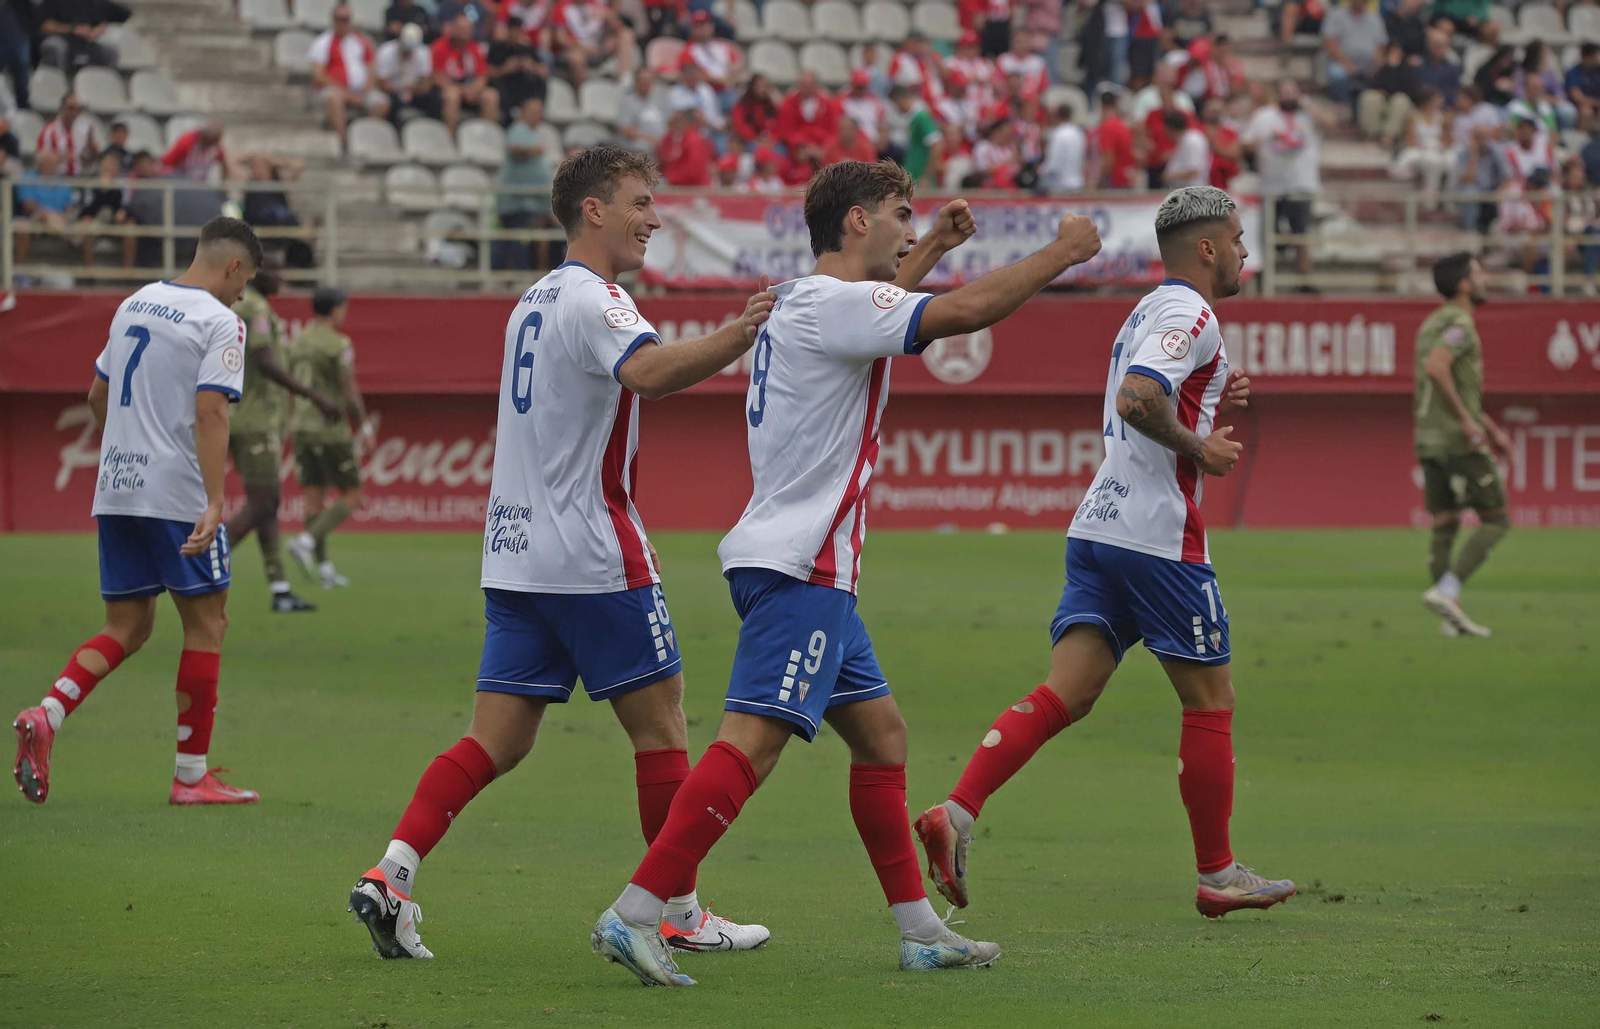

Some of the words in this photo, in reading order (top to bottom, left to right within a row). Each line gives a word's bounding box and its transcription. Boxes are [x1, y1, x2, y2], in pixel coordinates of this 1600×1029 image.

[120, 325, 151, 407] 7
[511, 310, 543, 415] 6
[1223, 314, 1397, 376] DERACIÓN
[748, 325, 773, 428] 9
[875, 428, 1101, 477] HYUNDA
[112, 468, 147, 490] Gusta
[491, 526, 529, 555] Gusta
[651, 584, 671, 627] 6
[803, 629, 828, 676] 9
